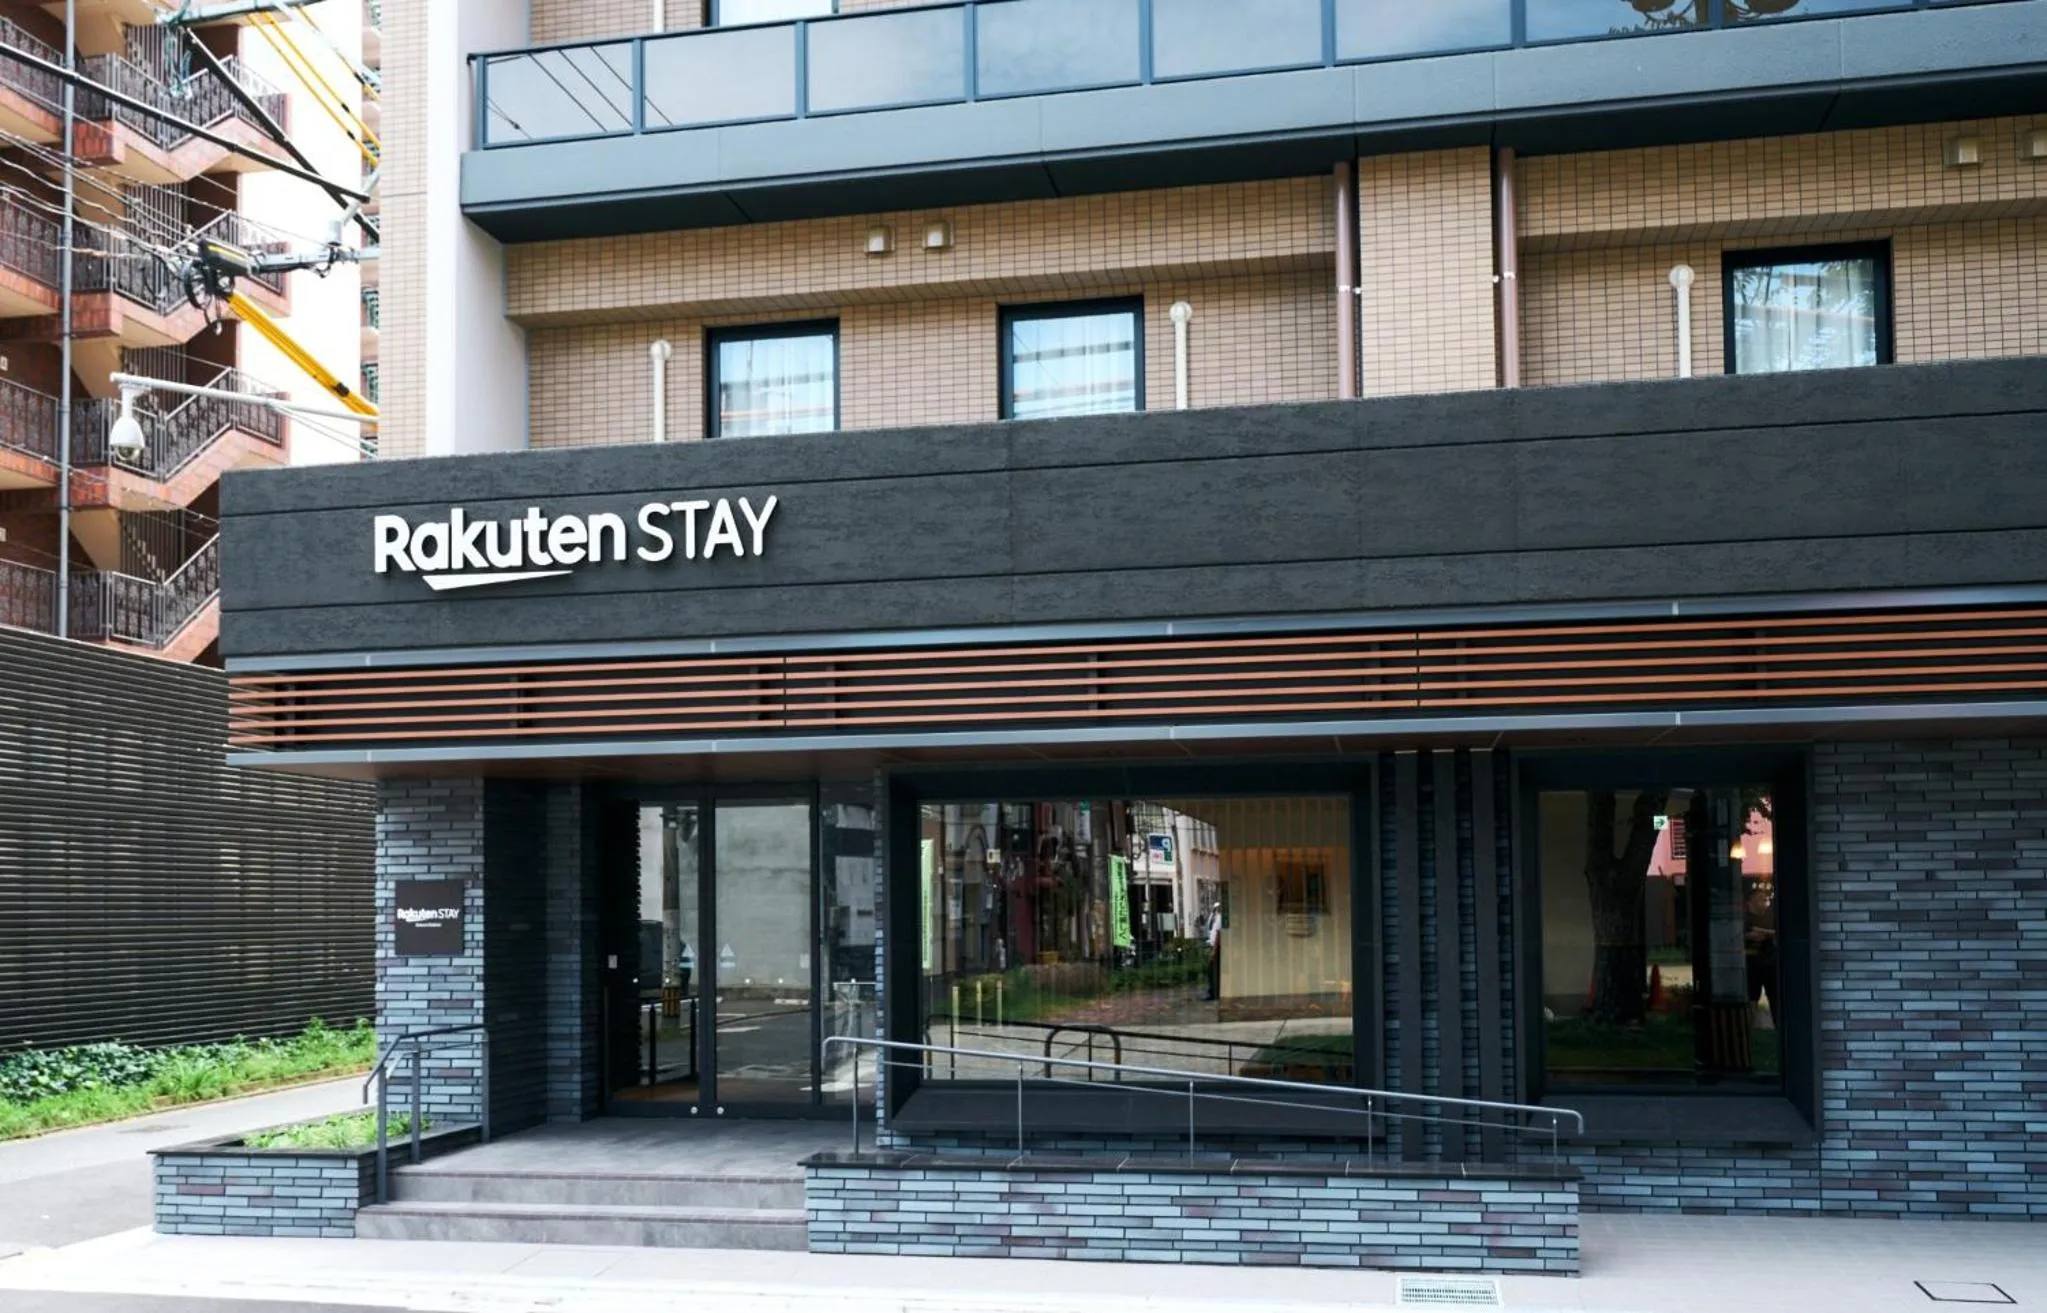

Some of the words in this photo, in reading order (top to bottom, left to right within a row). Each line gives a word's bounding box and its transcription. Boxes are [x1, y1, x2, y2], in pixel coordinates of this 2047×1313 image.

[374, 507, 627, 573] Rakuten
[637, 495, 778, 562] STAY
[438, 908, 460, 919] STAY
